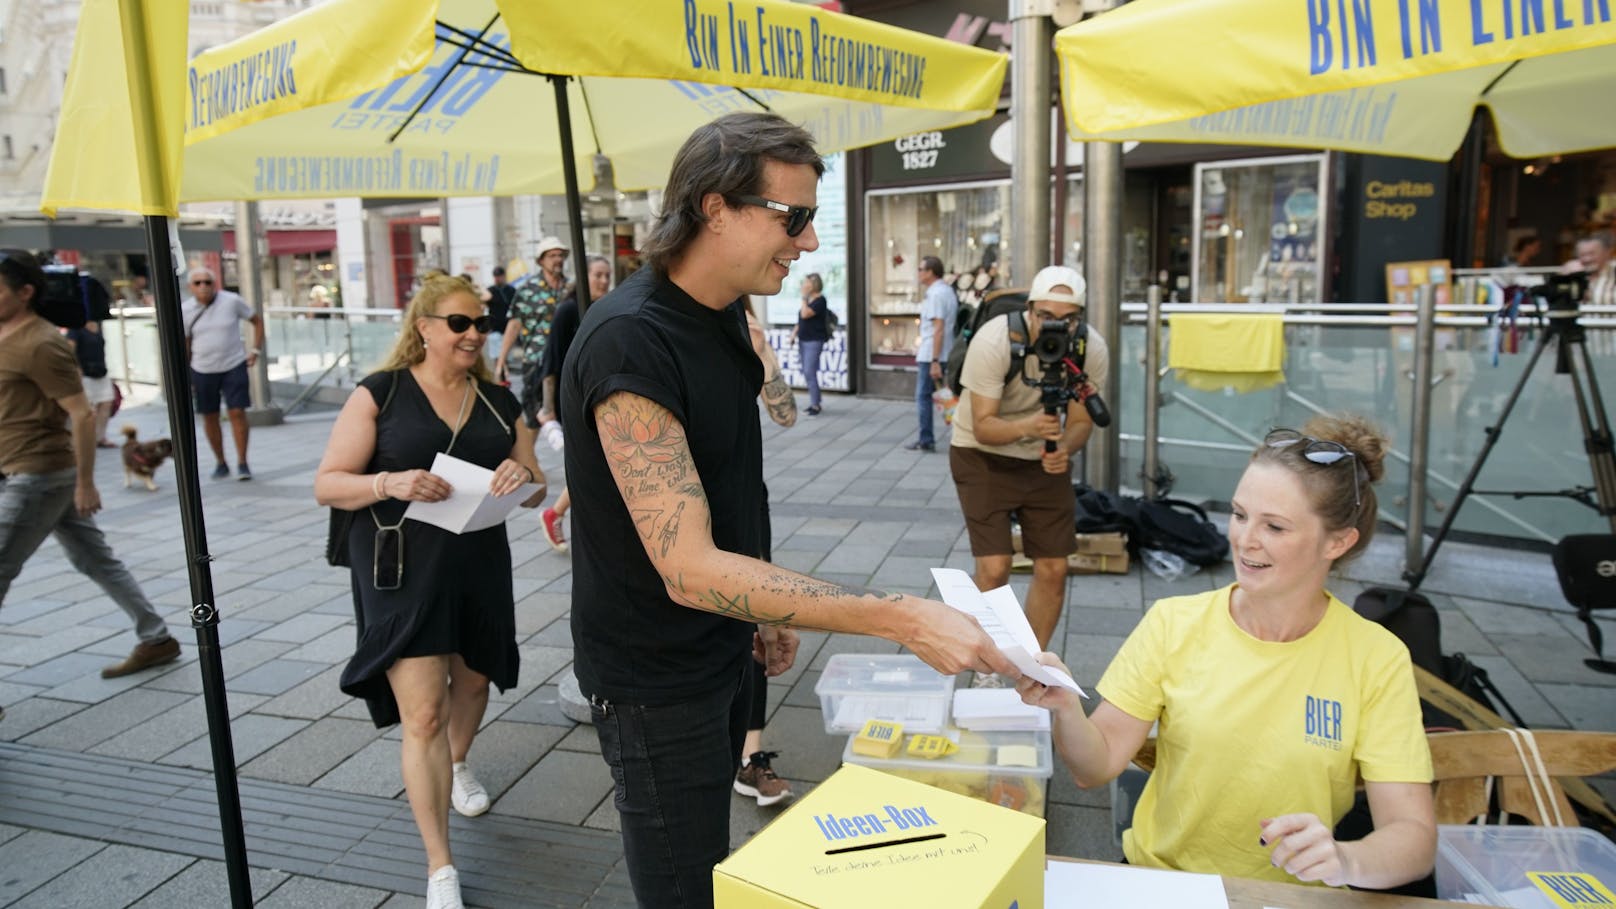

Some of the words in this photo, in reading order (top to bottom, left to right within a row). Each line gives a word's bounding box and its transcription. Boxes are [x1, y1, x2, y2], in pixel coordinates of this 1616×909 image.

[684, 0, 720, 71] BIN
[728, 2, 751, 74] IN
[756, 6, 804, 80] EINER
[810, 16, 927, 99] REFORMBEWEGUNG
[895, 131, 947, 152] GEGR.
[902, 150, 939, 170] 1827
[1366, 181, 1435, 198] Caritas
[1366, 201, 1417, 221] Shop
[1305, 695, 1342, 741] BIER
[813, 804, 938, 841] Ideen-Box
[1537, 874, 1615, 905] BIER
